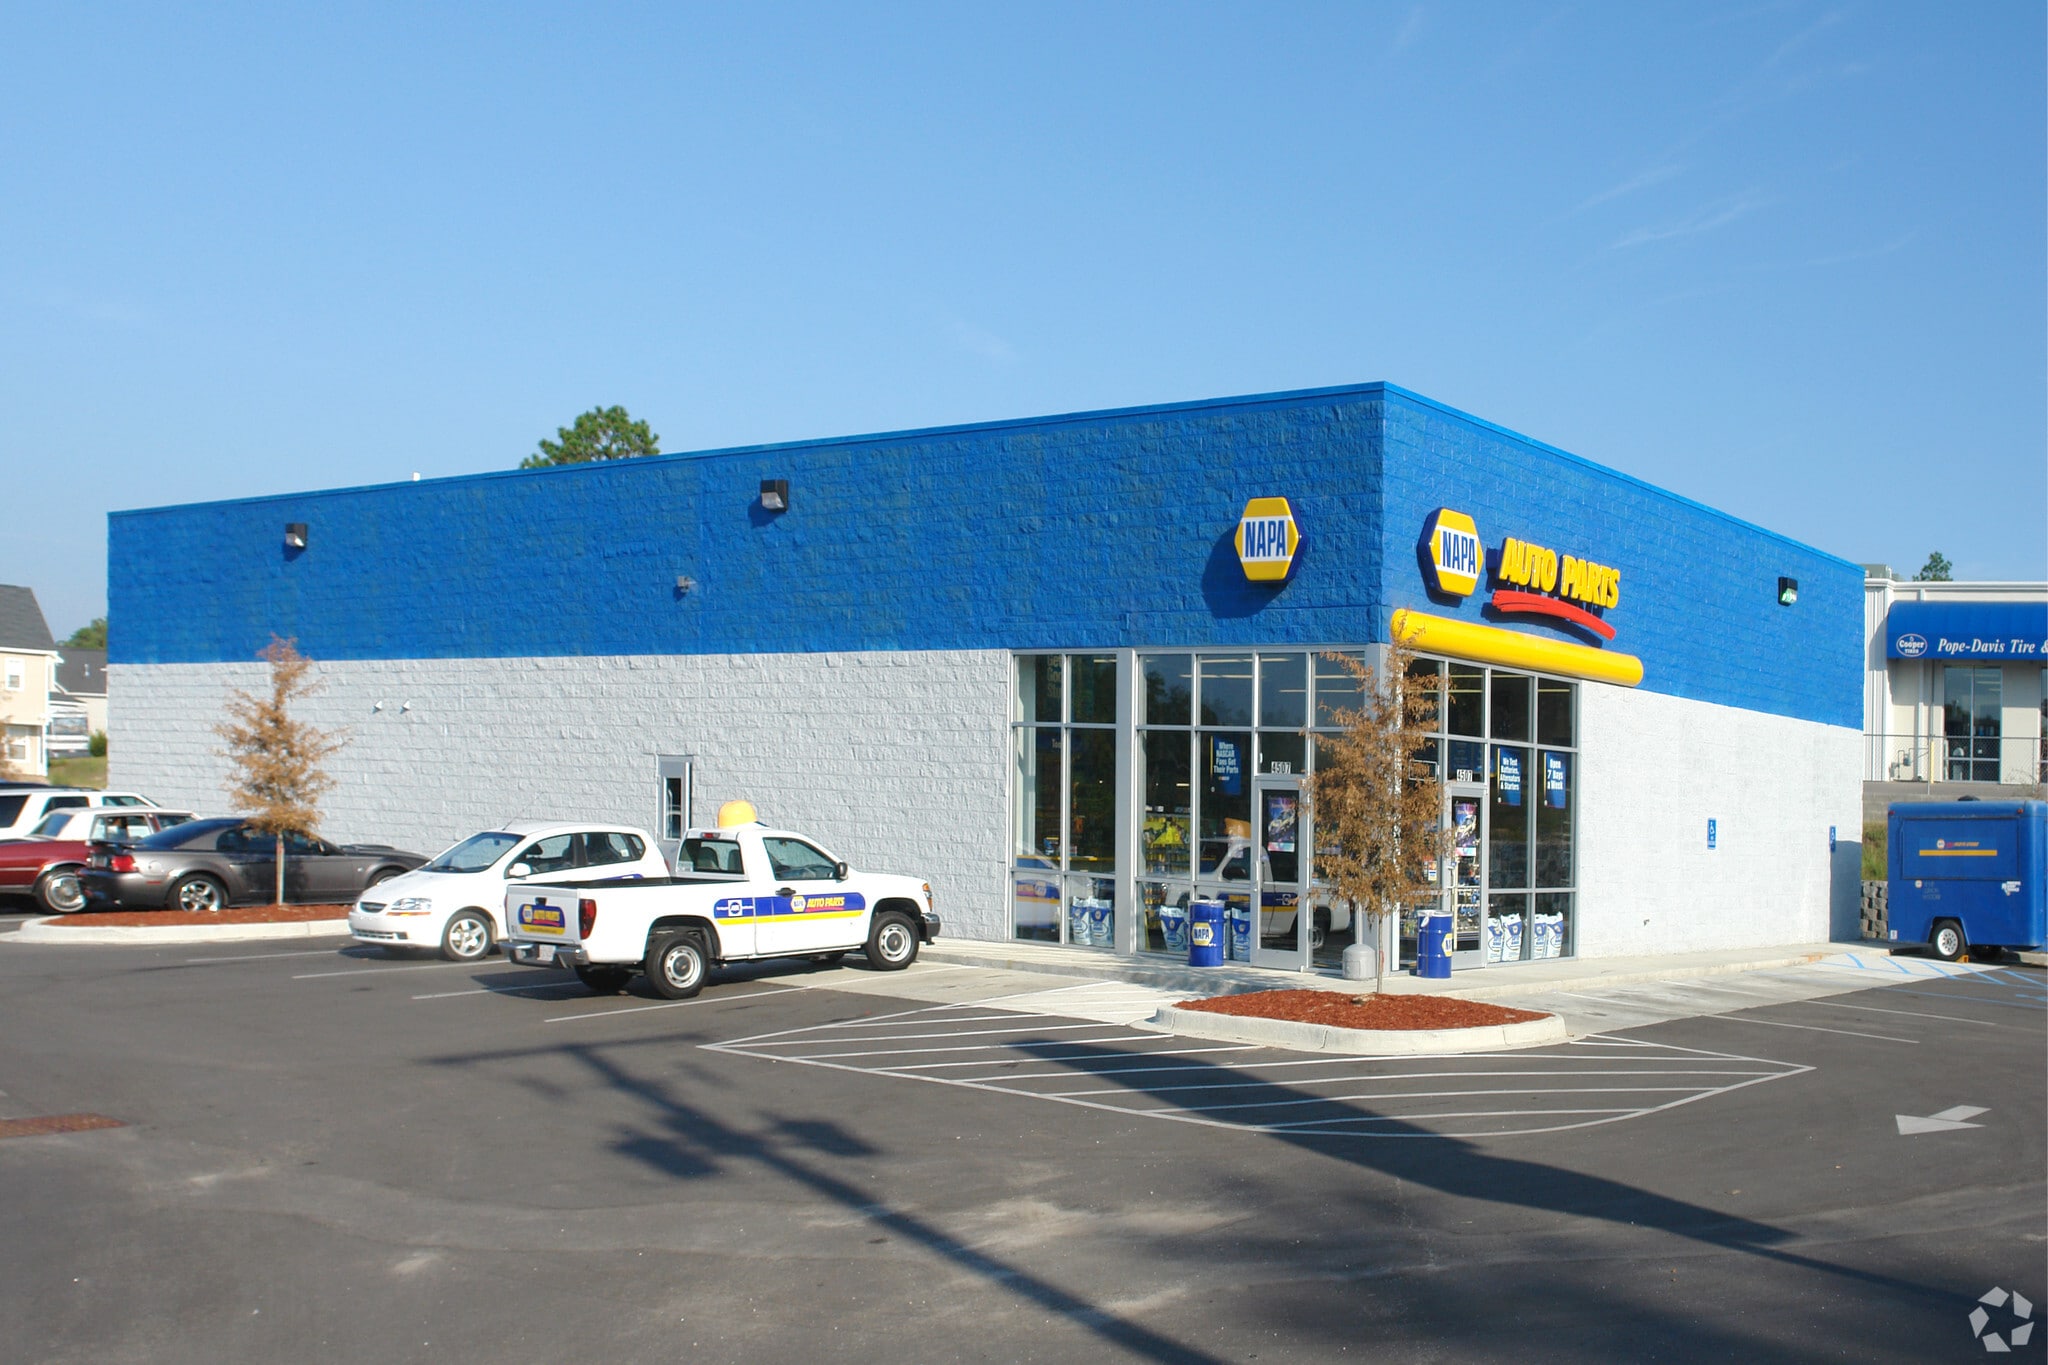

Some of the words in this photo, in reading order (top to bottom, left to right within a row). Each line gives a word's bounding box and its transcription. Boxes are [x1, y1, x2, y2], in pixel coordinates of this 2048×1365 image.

[1245, 520, 1286, 557] NAPA
[1442, 530, 1477, 575] NAPA
[1499, 536, 1558, 593] AUTO
[1560, 554, 1621, 610] PARTS
[1898, 640, 1925, 649] Cooper
[1937, 638, 2006, 655] Pope-Davis
[2010, 639, 2036, 654] Tire
[1216, 750, 1234, 758] NASCAR
[1216, 758, 1227, 766] Fans
[1271, 761, 1291, 774] 4507
[1550, 758, 1562, 769] Open
[1214, 766, 1226, 774] Their
[1226, 766, 1238, 774] Parts
[1457, 769, 1473, 781] 4507
[1548, 770, 1552, 779] 7
[1552, 769, 1564, 780] Days
[806, 898, 824, 908] AUTO
[1193, 928, 1210, 939] NAPA
